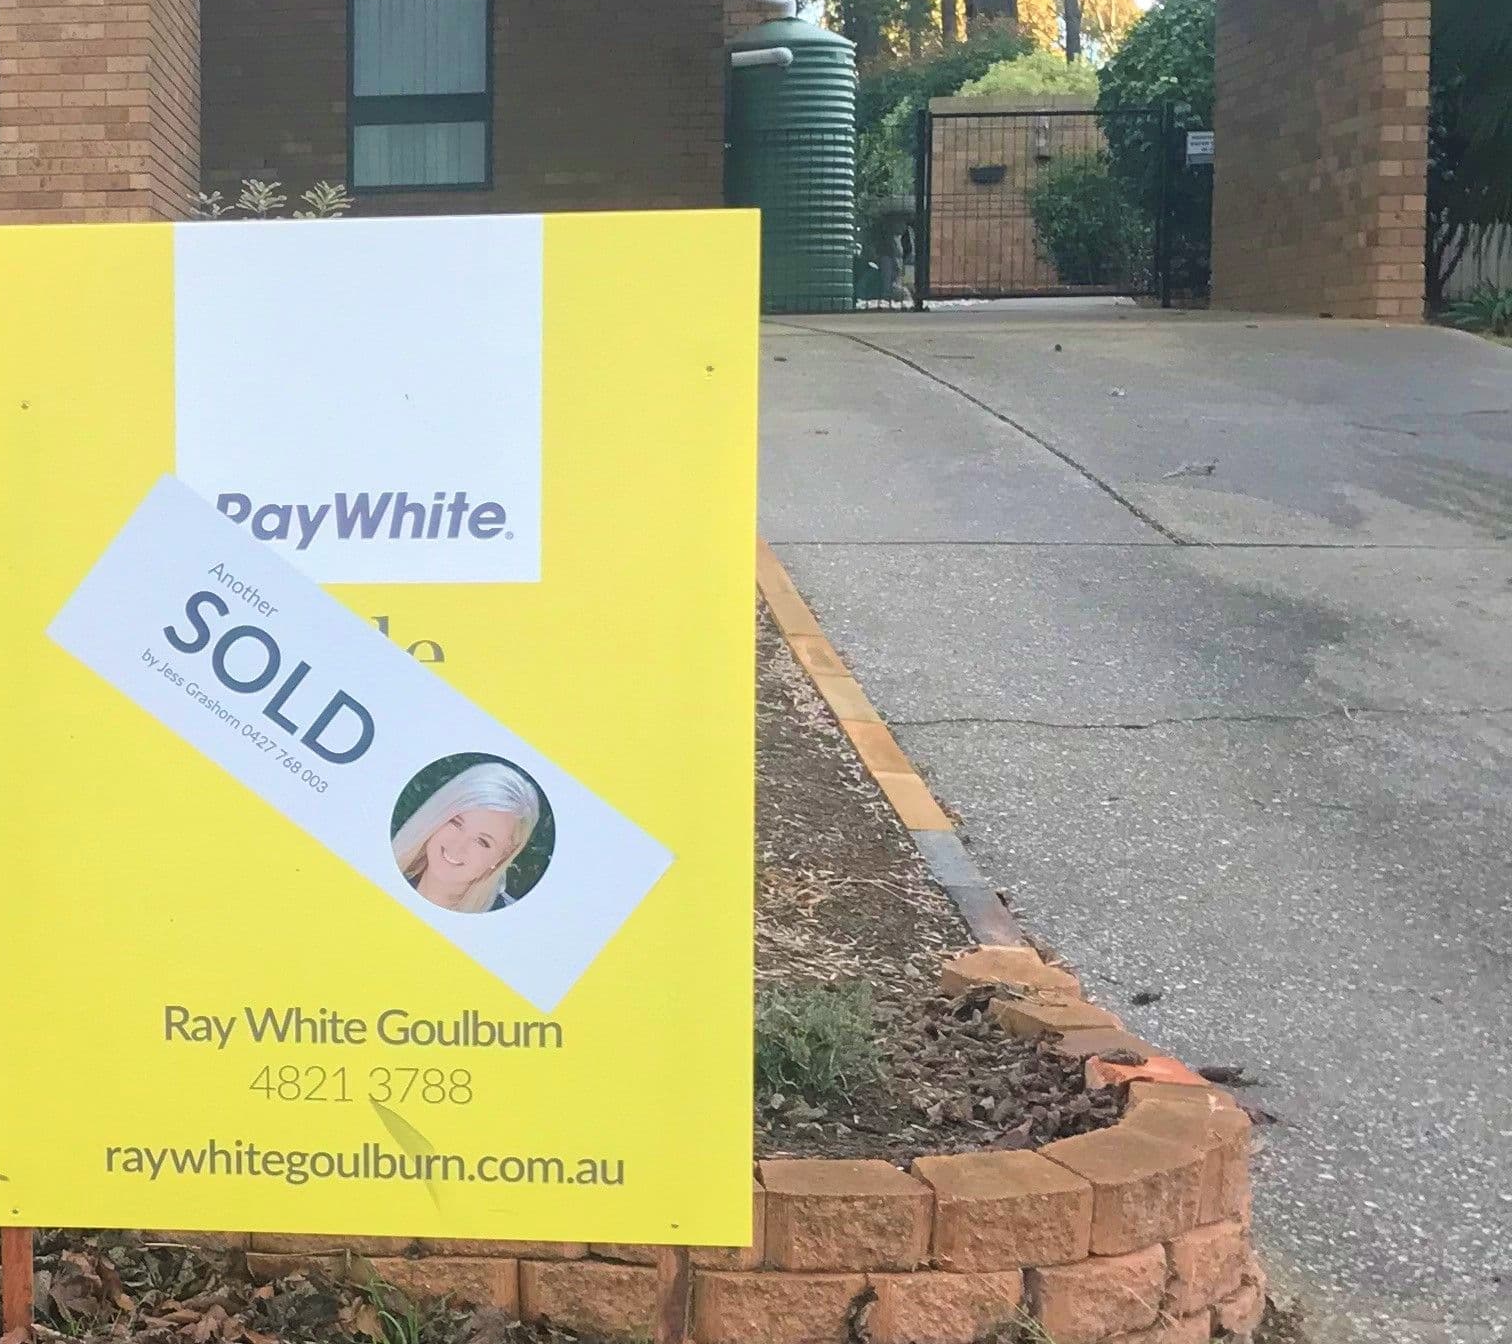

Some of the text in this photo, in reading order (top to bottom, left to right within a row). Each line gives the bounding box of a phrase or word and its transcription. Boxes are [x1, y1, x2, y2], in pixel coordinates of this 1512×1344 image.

[207, 562, 279, 618] Another
[162, 590, 376, 765] SOLD
[141, 647, 329, 793] by Jess Grashorn 0427 768 003
[164, 1005, 563, 1050] Ray White Goulburn
[248, 1065, 474, 1105] 4821 3788
[105, 1138, 625, 1186] raywhitegoulburn.com.au
